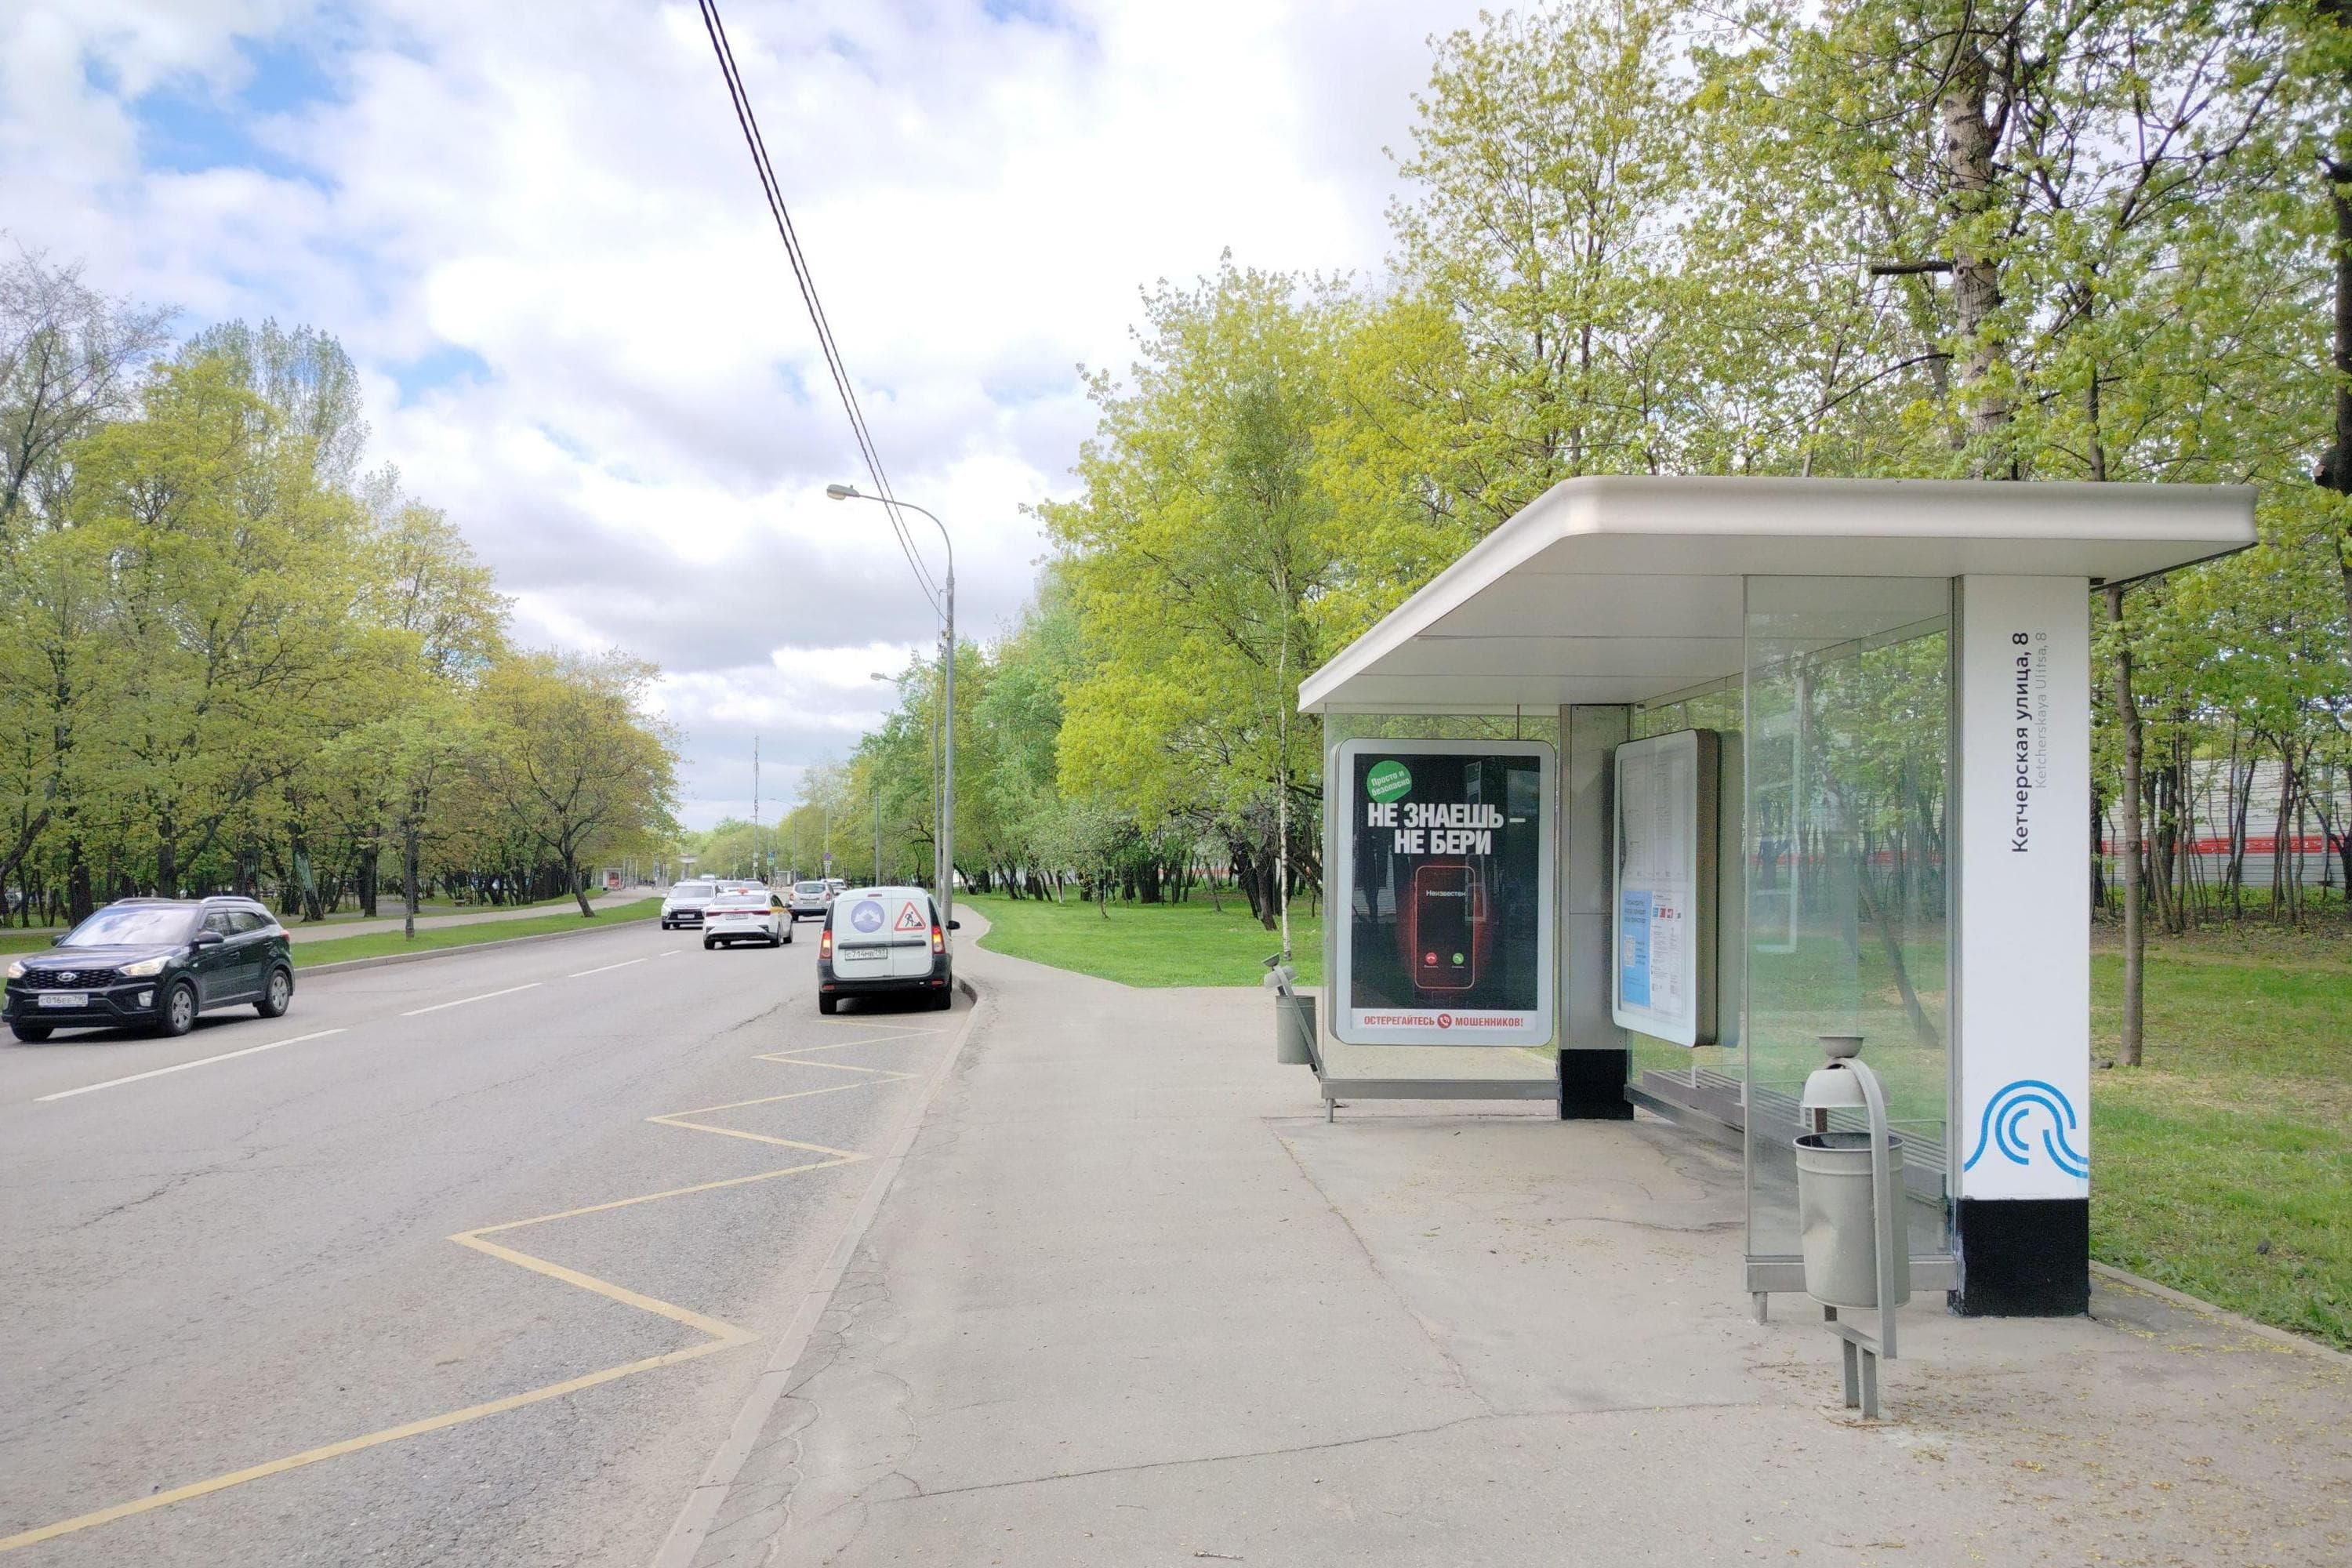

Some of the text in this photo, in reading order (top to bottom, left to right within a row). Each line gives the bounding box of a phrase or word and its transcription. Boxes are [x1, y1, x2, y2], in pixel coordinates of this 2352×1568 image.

[2035, 632, 2049, 789] Ketcherskaya Ulitsa, 8
[2012, 632, 2032, 853] Кетчерская улица, 8
[1371, 772, 1398, 787] Просто
[1371, 778, 1410, 797] безопасно
[1367, 803, 1398, 827] НЕ
[1403, 803, 1504, 829] ЗНАЕШЬ
[1394, 829, 1491, 855] НЕ БЕРИ
[1364, 1014, 1523, 1028] ОСТЕРЕГАЙТЕСЬ МОШЕННИКОВ!
